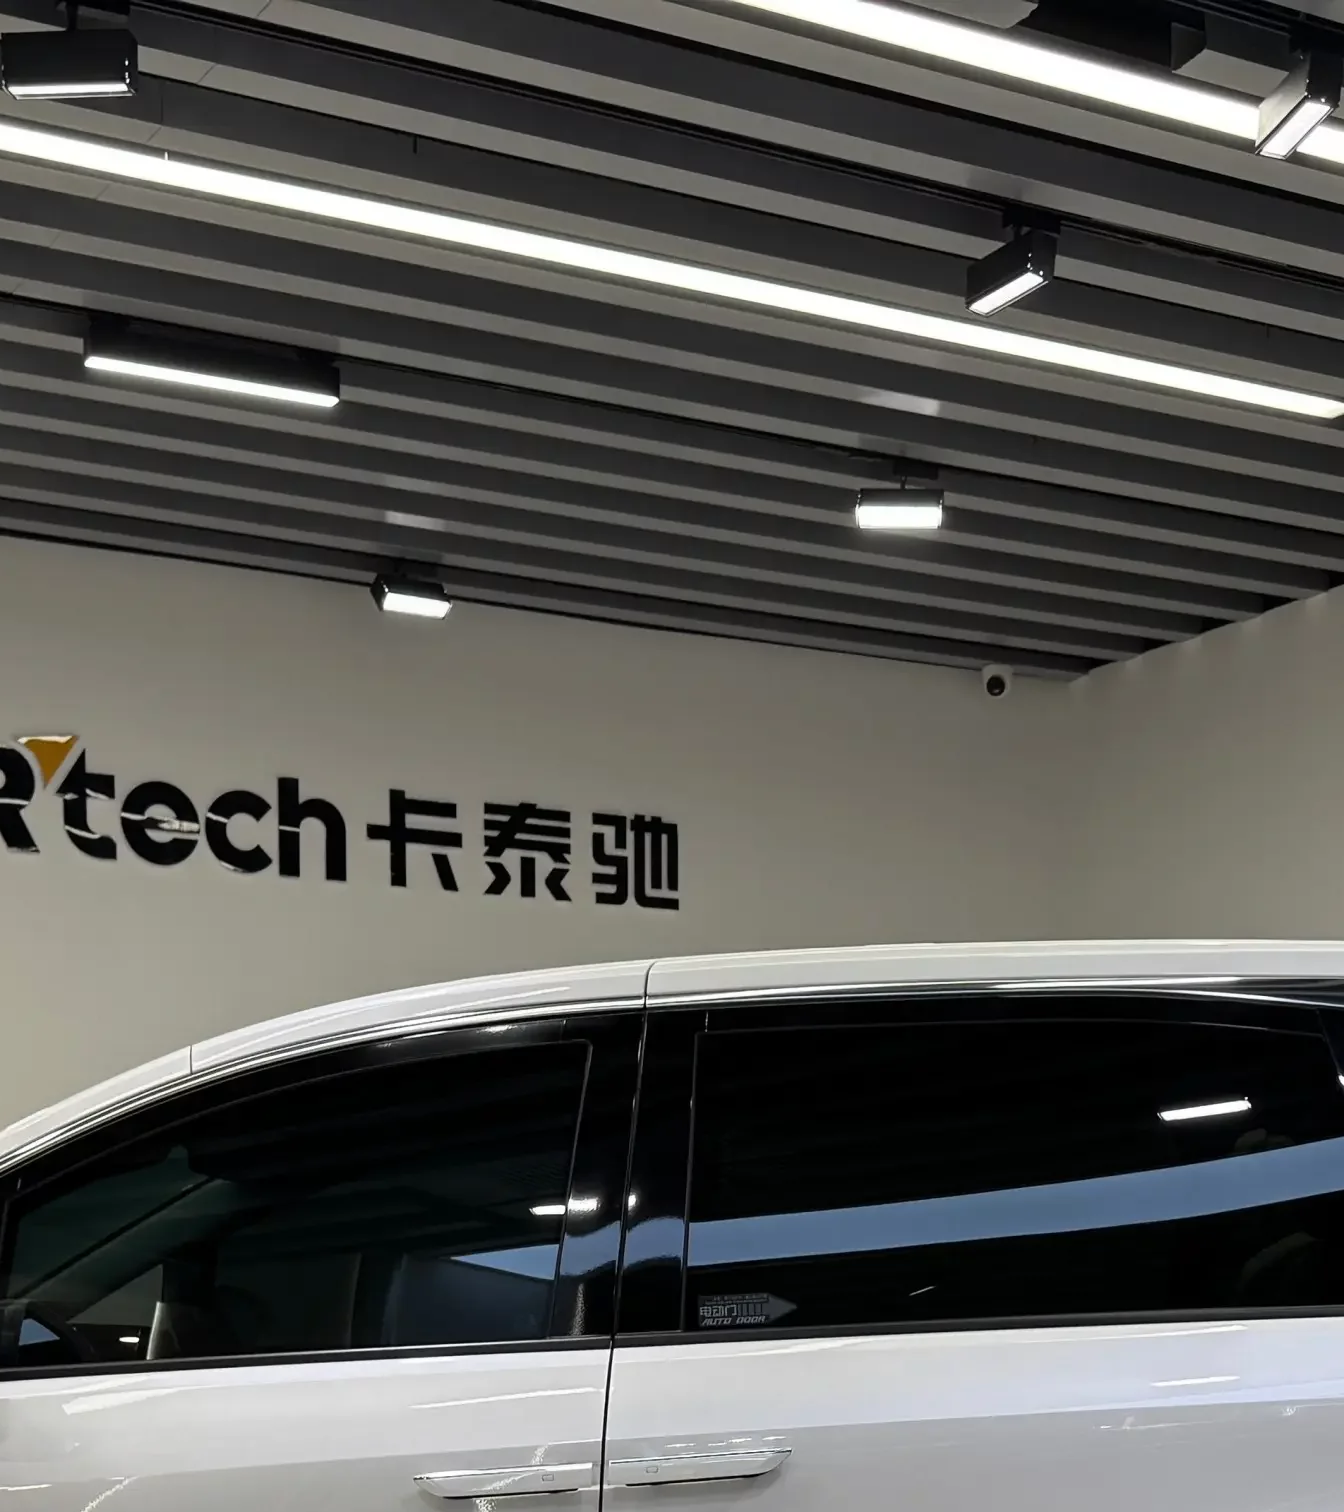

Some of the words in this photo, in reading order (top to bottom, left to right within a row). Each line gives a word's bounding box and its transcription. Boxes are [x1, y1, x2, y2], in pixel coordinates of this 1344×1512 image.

[365, 788, 680, 911] 卡泰驰
[699, 1304, 737, 1317] 电动门
[702, 1317, 732, 1326] AUTO
[736, 1315, 766, 1324] DOOR
